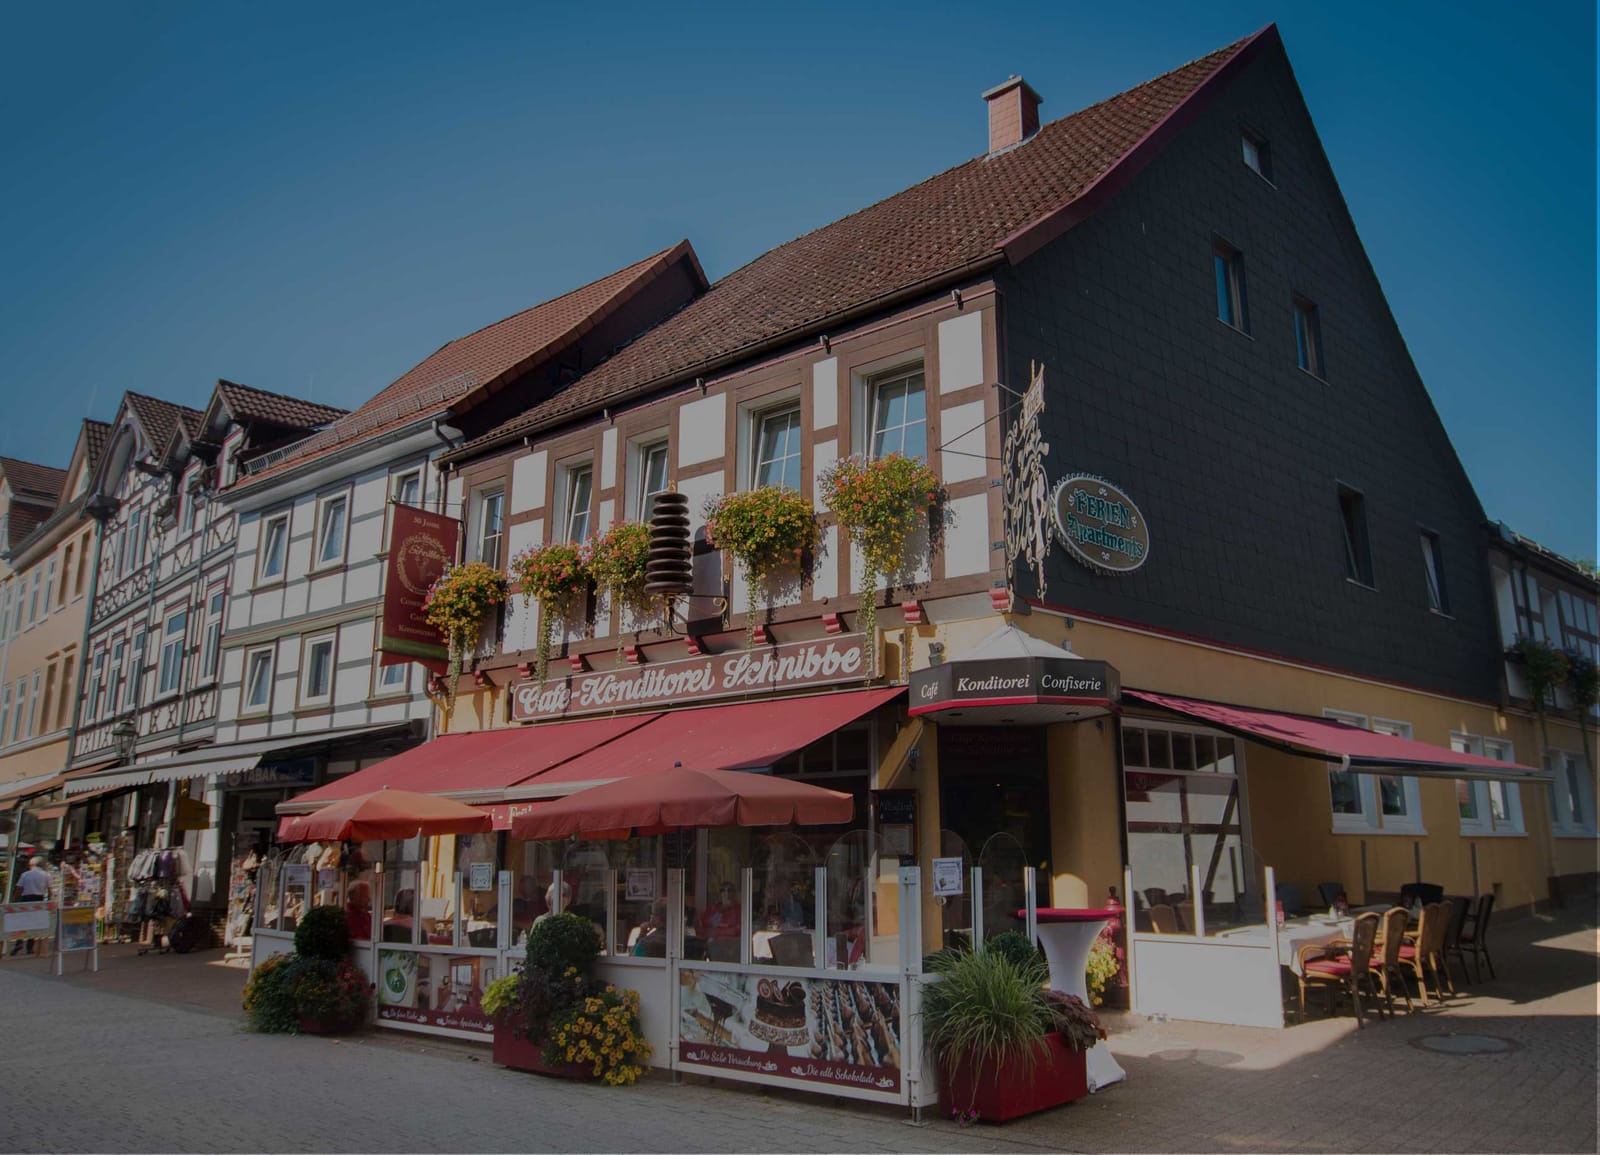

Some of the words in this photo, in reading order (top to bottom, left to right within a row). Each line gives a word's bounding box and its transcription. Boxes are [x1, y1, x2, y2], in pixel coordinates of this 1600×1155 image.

[1073, 488, 1130, 529] FERIEN
[1066, 512, 1144, 561] Apartments
[723, 642, 862, 689] Schnibbe
[921, 681, 938, 698] Café
[957, 674, 1030, 692] Konditorei
[1041, 674, 1101, 692] Confiserie
[243, 766, 278, 784] TABAK
[806, 1063, 818, 1078] Die
[819, 1065, 833, 1079] edle
[835, 1067, 875, 1084] Schokolade
